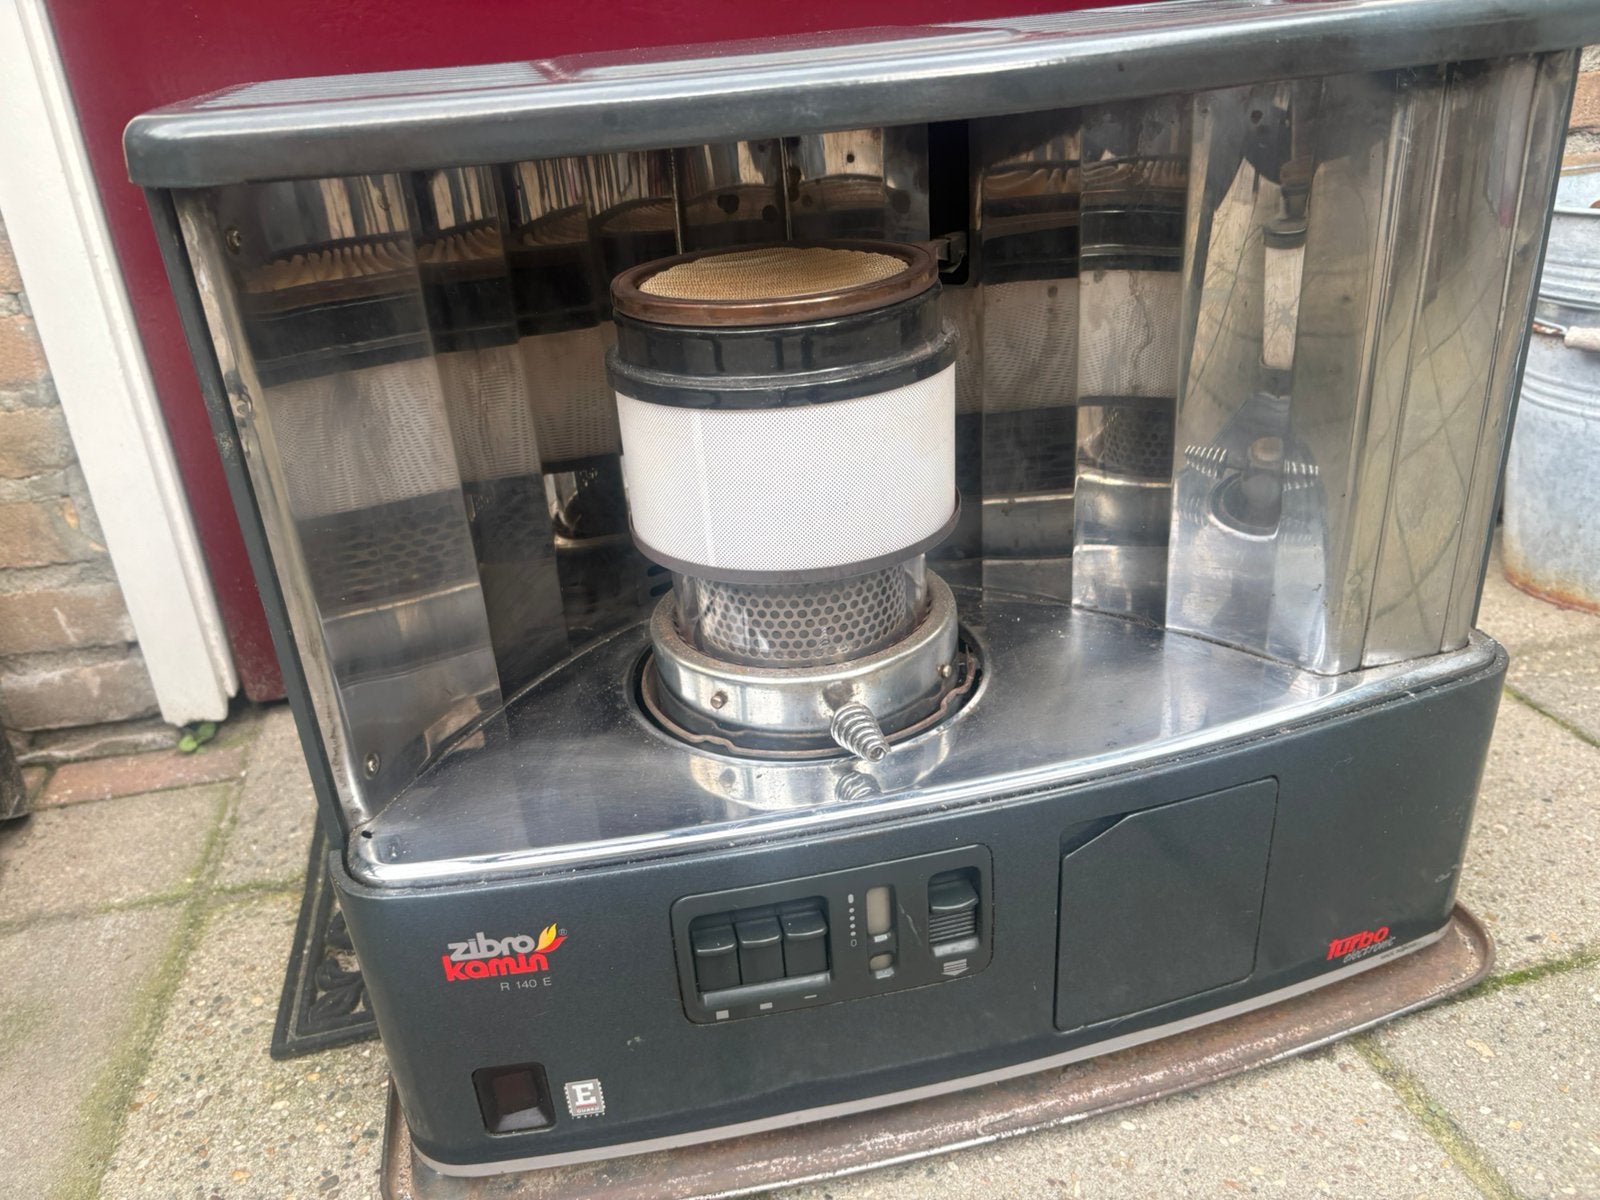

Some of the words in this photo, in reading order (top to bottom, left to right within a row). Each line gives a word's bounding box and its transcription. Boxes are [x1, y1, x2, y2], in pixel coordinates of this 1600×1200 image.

[448, 932, 535, 961] zibro
[441, 952, 549, 982] kamin
[500, 982, 510, 991] R
[516, 979, 538, 990] 140
[543, 977, 552, 986] E
[572, 1083, 596, 1106] E
